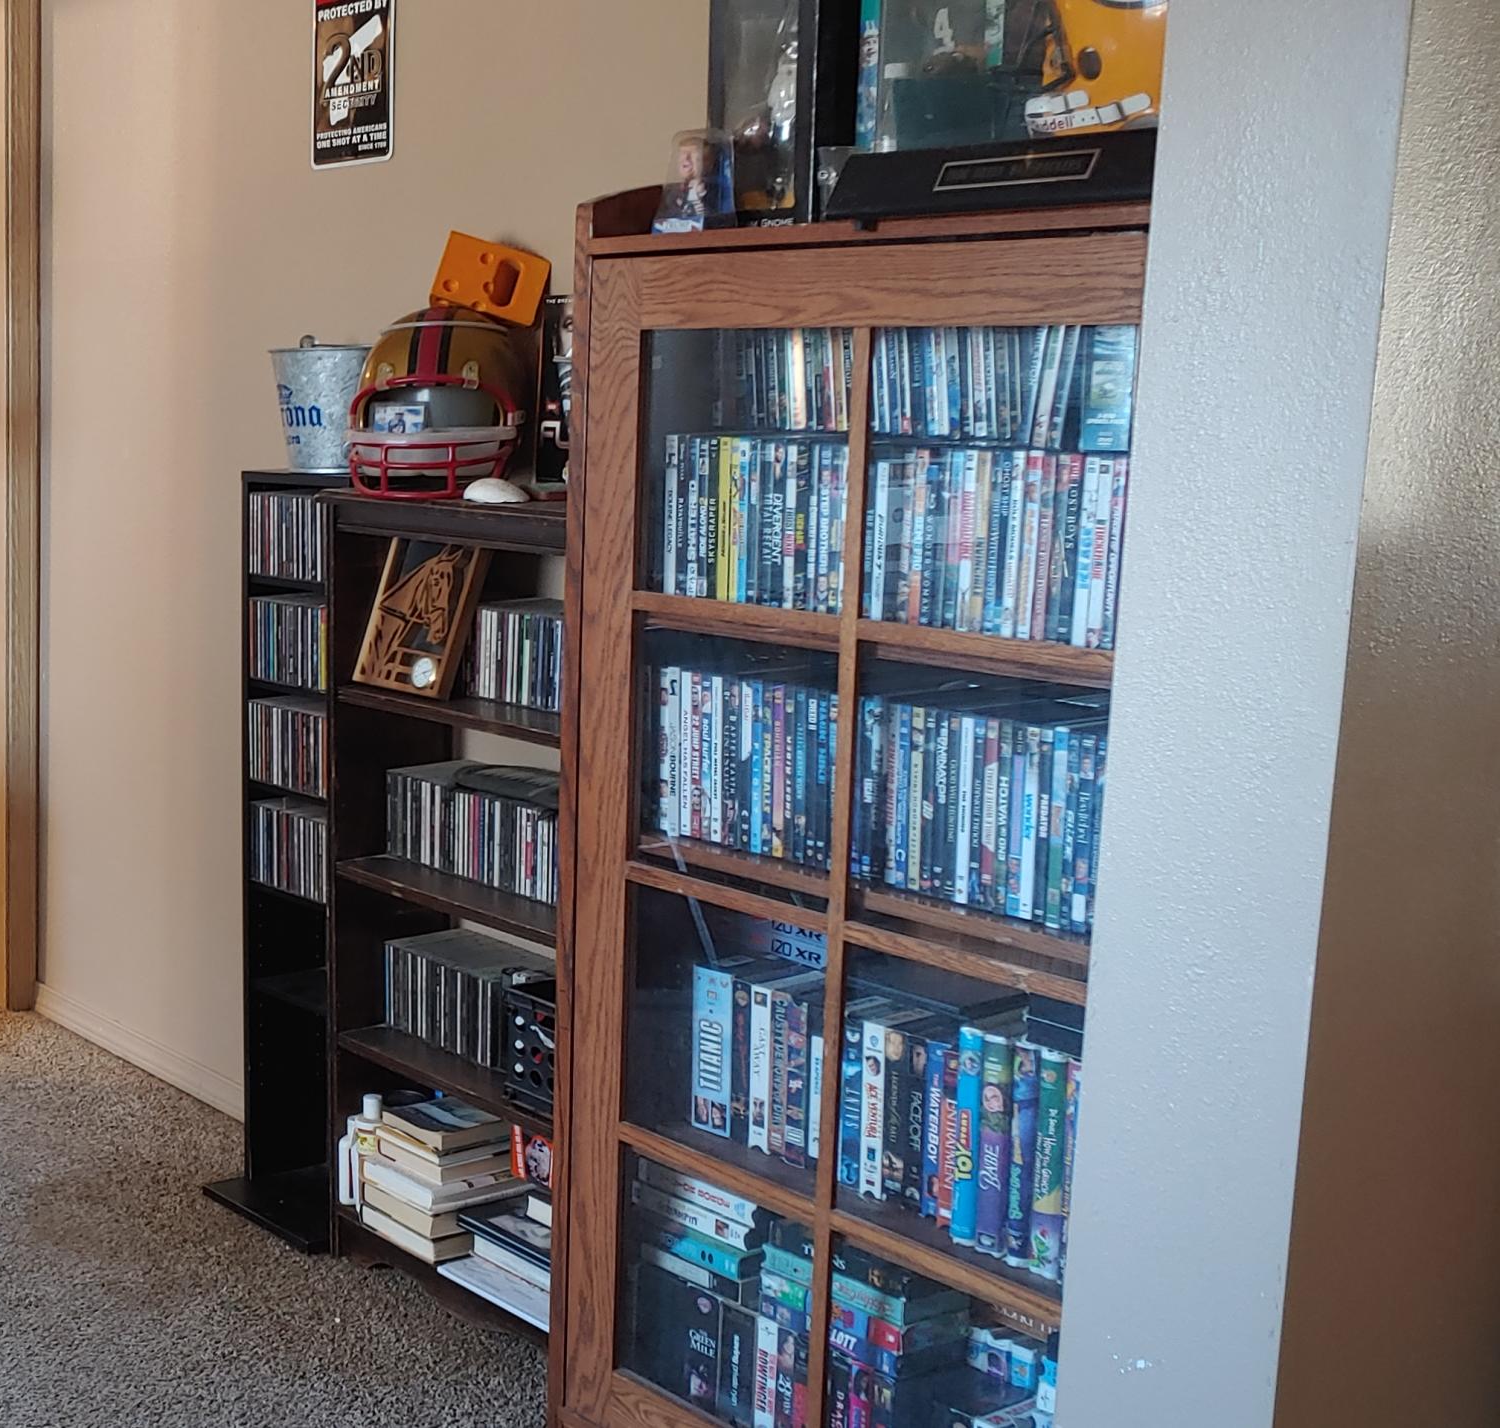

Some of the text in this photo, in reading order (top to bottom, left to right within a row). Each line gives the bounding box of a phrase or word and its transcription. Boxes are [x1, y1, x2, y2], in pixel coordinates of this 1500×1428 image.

[318, 0, 387, 22] PROTECTED BY
[323, 33, 383, 100] 2ND
[325, 79, 380, 99] AMENDMENT
[316, 122, 387, 141] PROTECTING AMERICANS
[316, 130, 387, 149] ONE SHOT AT A TIME
[761, 217, 794, 227] GNOME
[1001, 461, 1012, 517] GHOST SHIP
[1064, 461, 1082, 550] THE LOST BOYS
[677, 497, 685, 549] RATATOUILLE
[707, 497, 717, 564] SKYSCRAPER
[771, 493, 783, 566] DIVERGENT
[818, 518, 829, 575] BROTHERS
[921, 515, 935, 614] WONDER WOMAN
[988, 533, 1000, 565] WITCH
[681, 709, 690, 744] ANGEL
[807, 698, 818, 724] CREED
[681, 747, 689, 769] HAS
[691, 727, 700, 752] JUMP
[701, 718, 711, 776] soul surfer
[937, 720, 949, 804] TERMINATOR
[668, 754, 678, 797] BOURNE
[690, 752, 700, 780] STREET
[762, 733, 773, 814] SPACEBALLS
[998, 775, 1010, 827] WATCH
[1023, 793, 1035, 841] wonder
[1039, 793, 1049, 839] PREDATOR
[971, 817, 981, 849] DOUBLE
[997, 837, 1007, 861] END
[771, 938, 822, 965] 120 XR
[795, 927, 823, 942] XR
[774, 999, 789, 1040] CRUSTY
[699, 1019, 724, 1093] TITANIC
[865, 1082, 879, 1139] ACE VENTURA
[889, 1070, 901, 1108] LEGENDS
[909, 1090, 923, 1153] FACE/OFF
[927, 1073, 942, 1164] THE WATERBOY
[943, 1097, 959, 1191] ENTRAPMENT
[954, 1111, 974, 1181] TOY STORY
[979, 1143, 1001, 1192] BABE
[688, 1328, 716, 1360] GREEN MILE
[730, 1390, 739, 1408] ryan
[731, 1363, 740, 1391] private
[755, 1348, 769, 1413] BOWFINGER
[776, 1372, 793, 1416] 28 DAYS
